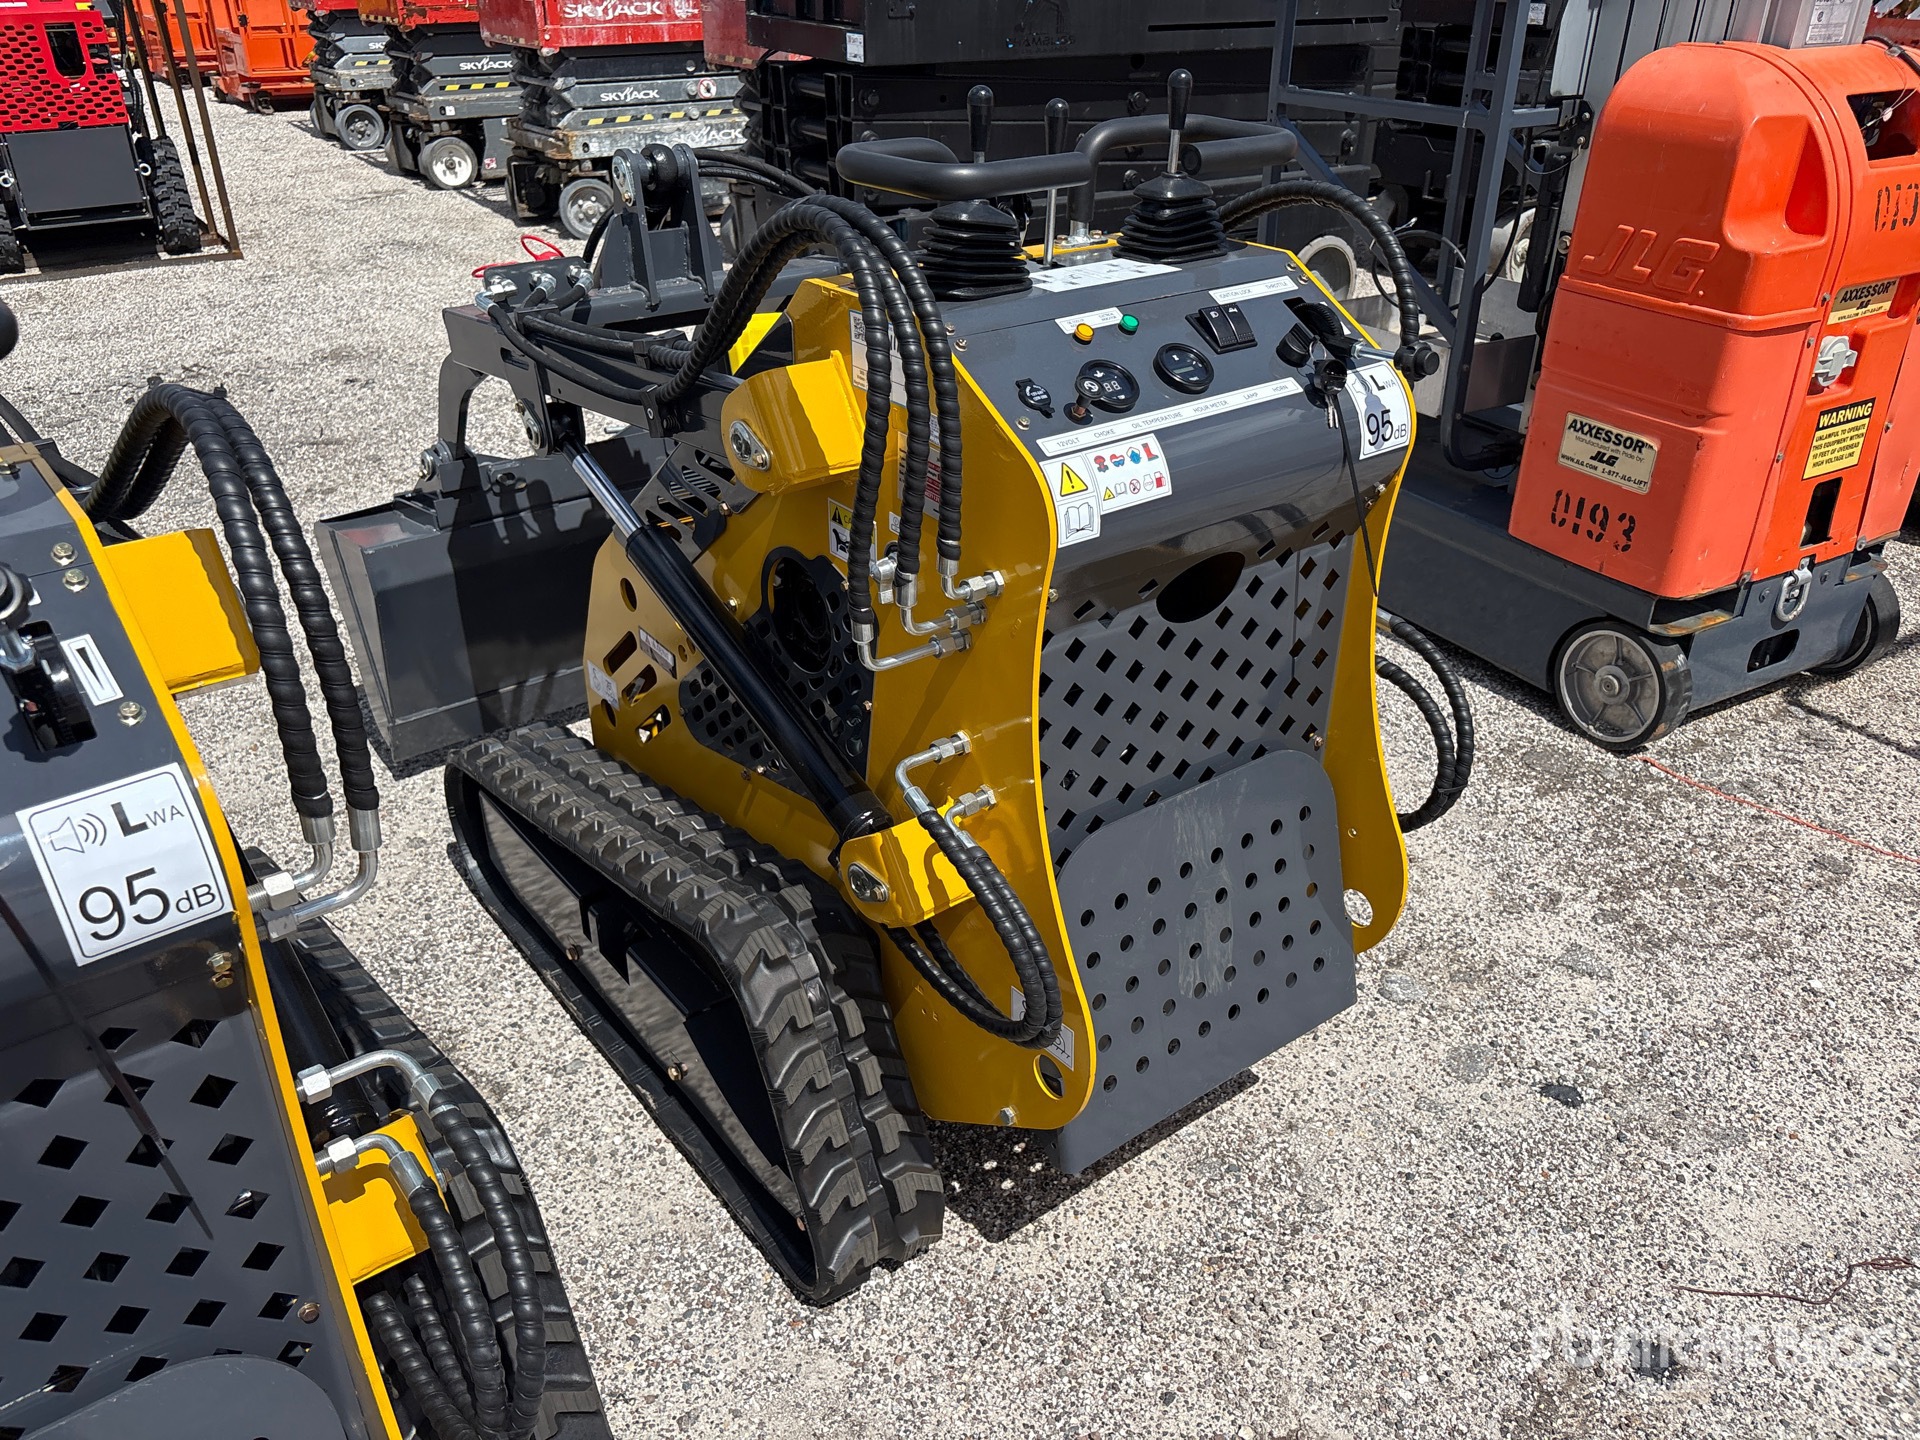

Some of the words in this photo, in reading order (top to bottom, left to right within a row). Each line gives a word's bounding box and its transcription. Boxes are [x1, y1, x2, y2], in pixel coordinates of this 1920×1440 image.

[563, 0, 664, 20] SKYJACK
[459, 56, 514, 71] SKYJACK
[600, 87, 660, 102] SKYJACK
[1579, 224, 1721, 294] JLG
[1243, 392, 1258, 400] LAMP
[1271, 384, 1289, 393] HORN
[1193, 404, 1209, 414] HOUR
[1209, 400, 1228, 411] METER
[1819, 402, 1873, 428] WARNING
[1131, 418, 1144, 429] OIL
[1144, 411, 1183, 426] TEMPERATURE
[1094, 428, 1116, 438] CHOKE
[1815, 430, 1840, 442] UNLAWFUL
[1840, 428, 1847, 436] TO
[1846, 423, 1867, 434] OPERATE
[1056, 437, 1080, 447] 12VOLT
[1575, 435, 1610, 452] Manufactured
[1610, 446, 1621, 455] with
[1621, 449, 1635, 460] Pride
[1812, 443, 1823, 452] THIS
[1823, 436, 1849, 449] EQUIPMENT
[1849, 432, 1865, 441] WITHIN
[1818, 449, 1830, 458] FEET
[1837, 441, 1860, 453] OVERHEAD
[1589, 450, 1619, 467] JLG
[1812, 459, 1824, 468] HIGH
[1824, 453, 1845, 464] VOLTAGE
[1844, 450, 1855, 459] LINE
[1601, 467, 1648, 487] 1-877-JLG-LIFT
[1551, 489, 1636, 552] 0193
